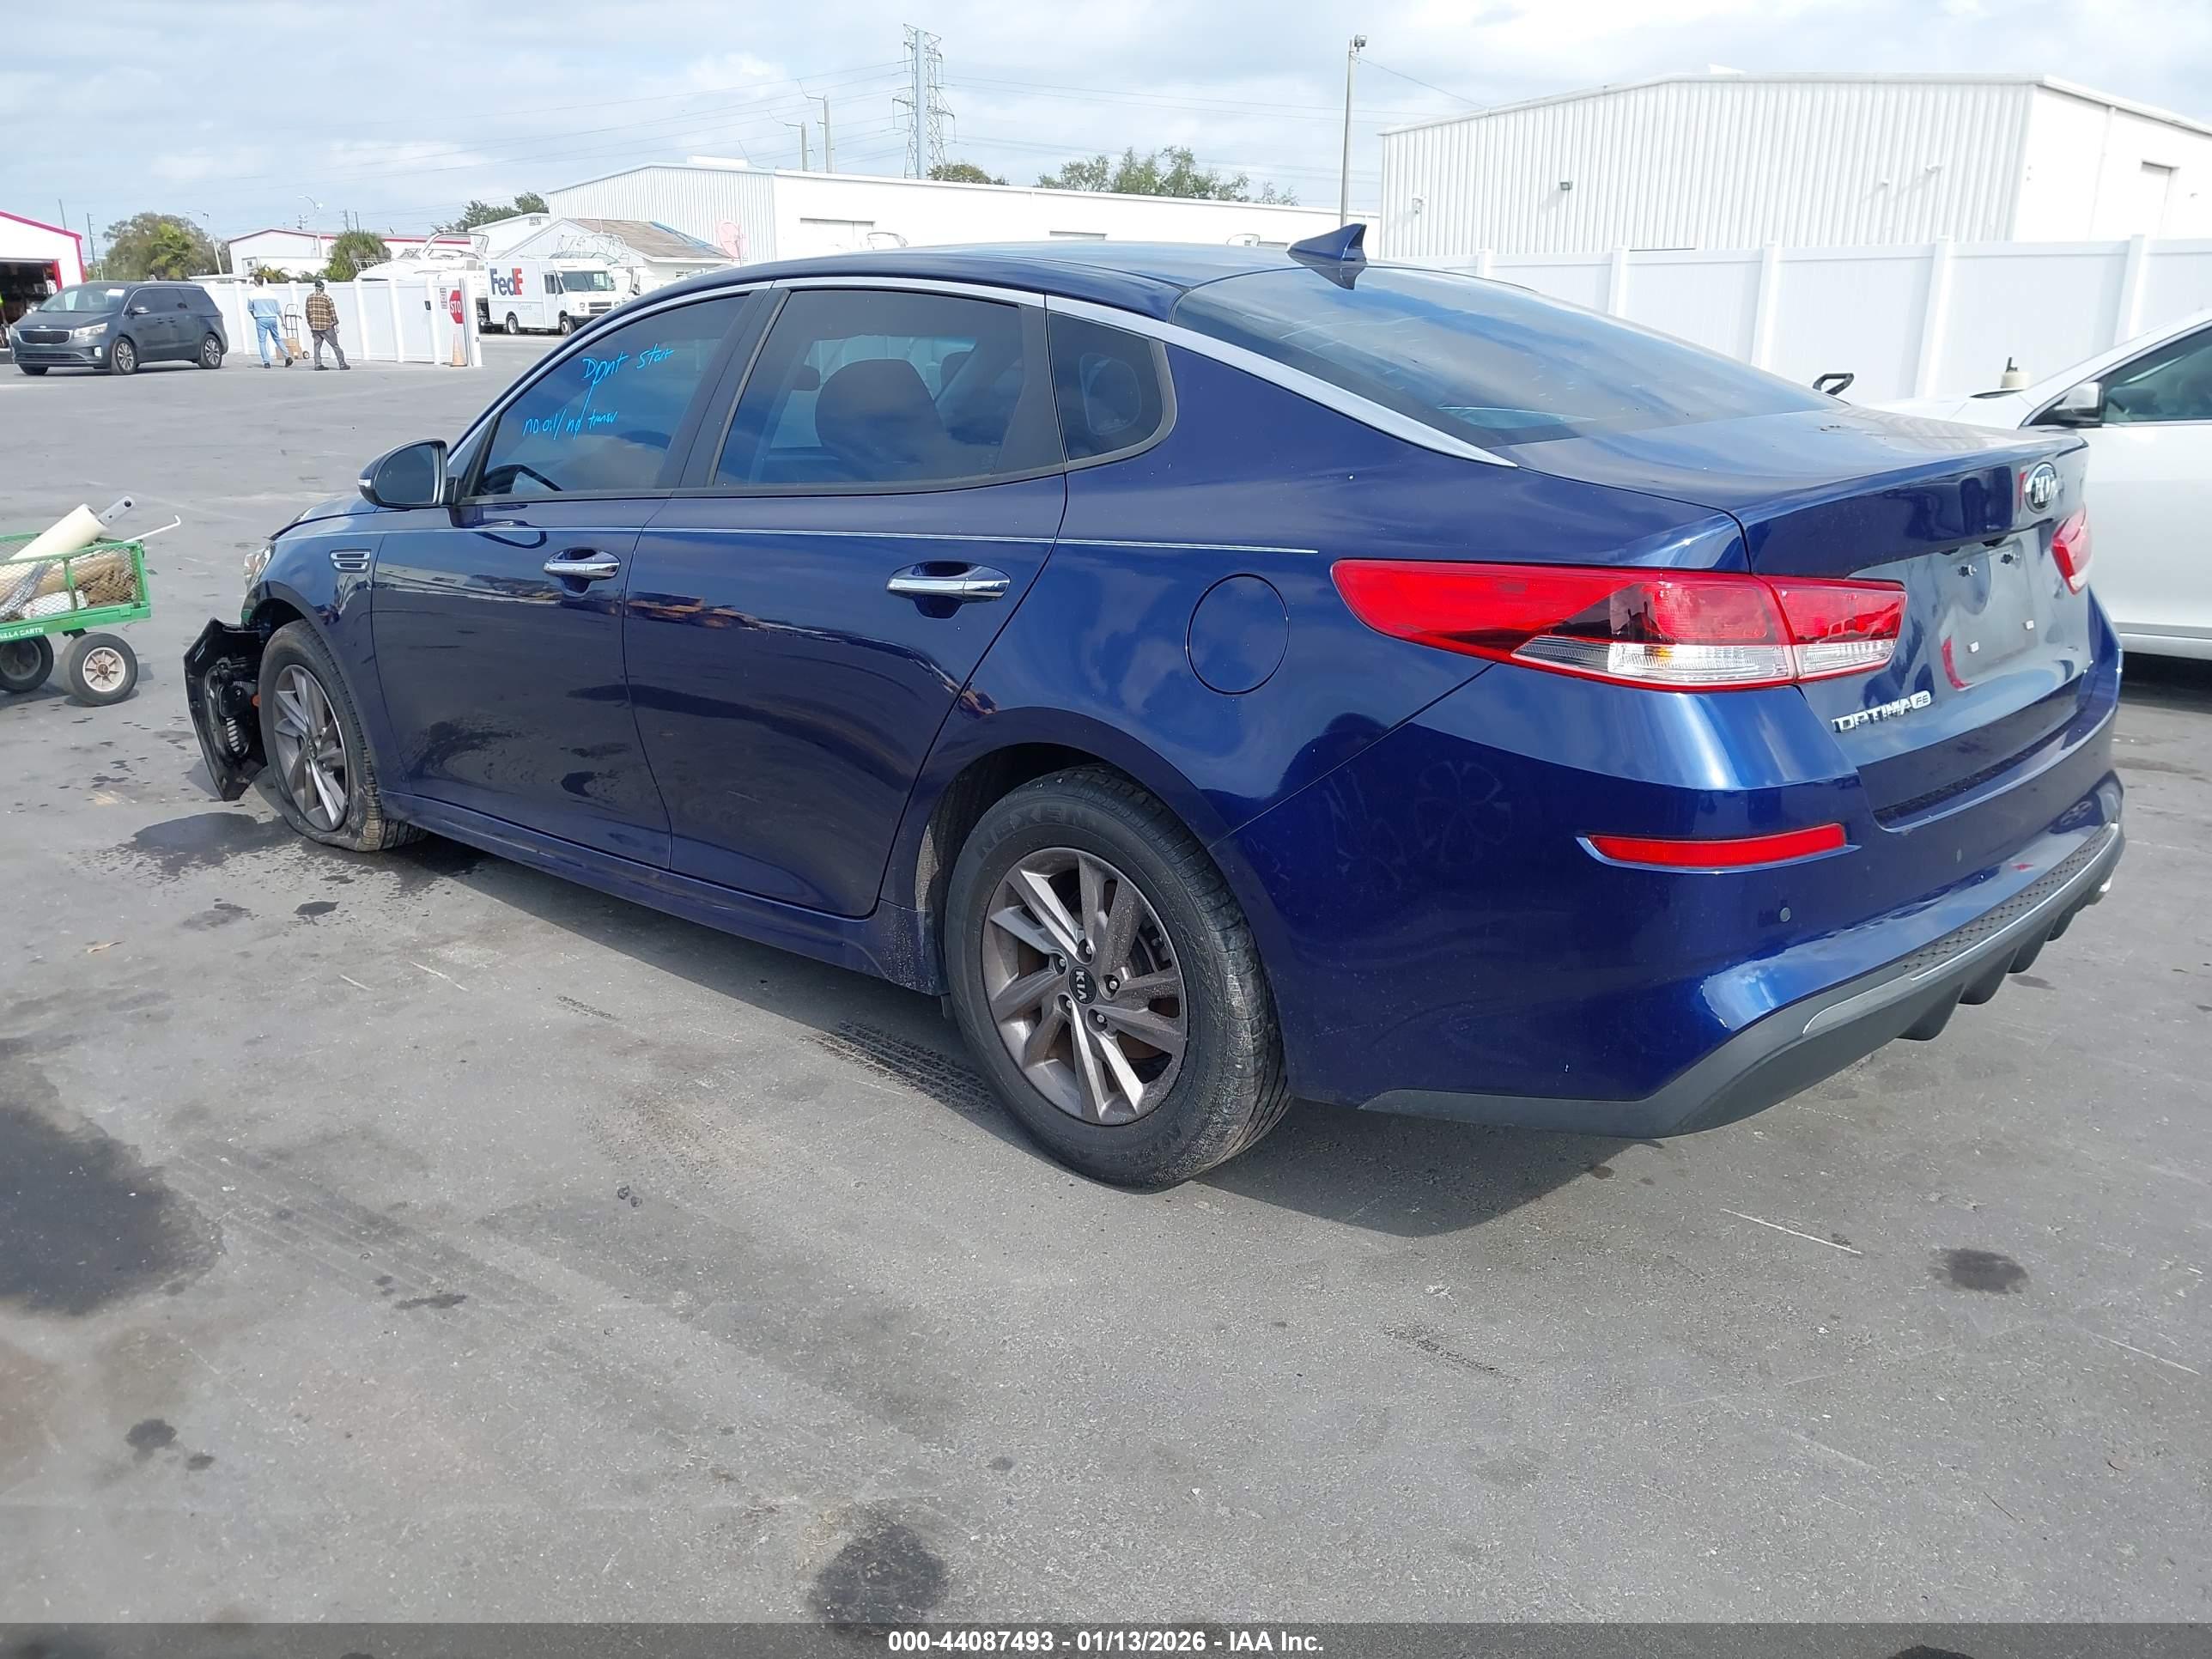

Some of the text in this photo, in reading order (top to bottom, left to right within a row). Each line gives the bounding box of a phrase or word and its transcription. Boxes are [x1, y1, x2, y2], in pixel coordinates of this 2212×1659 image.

[450, 301, 462, 313] STO
[1831, 694, 1929, 733] OPTIMA FE
[1075, 970, 1087, 1001] KIA
